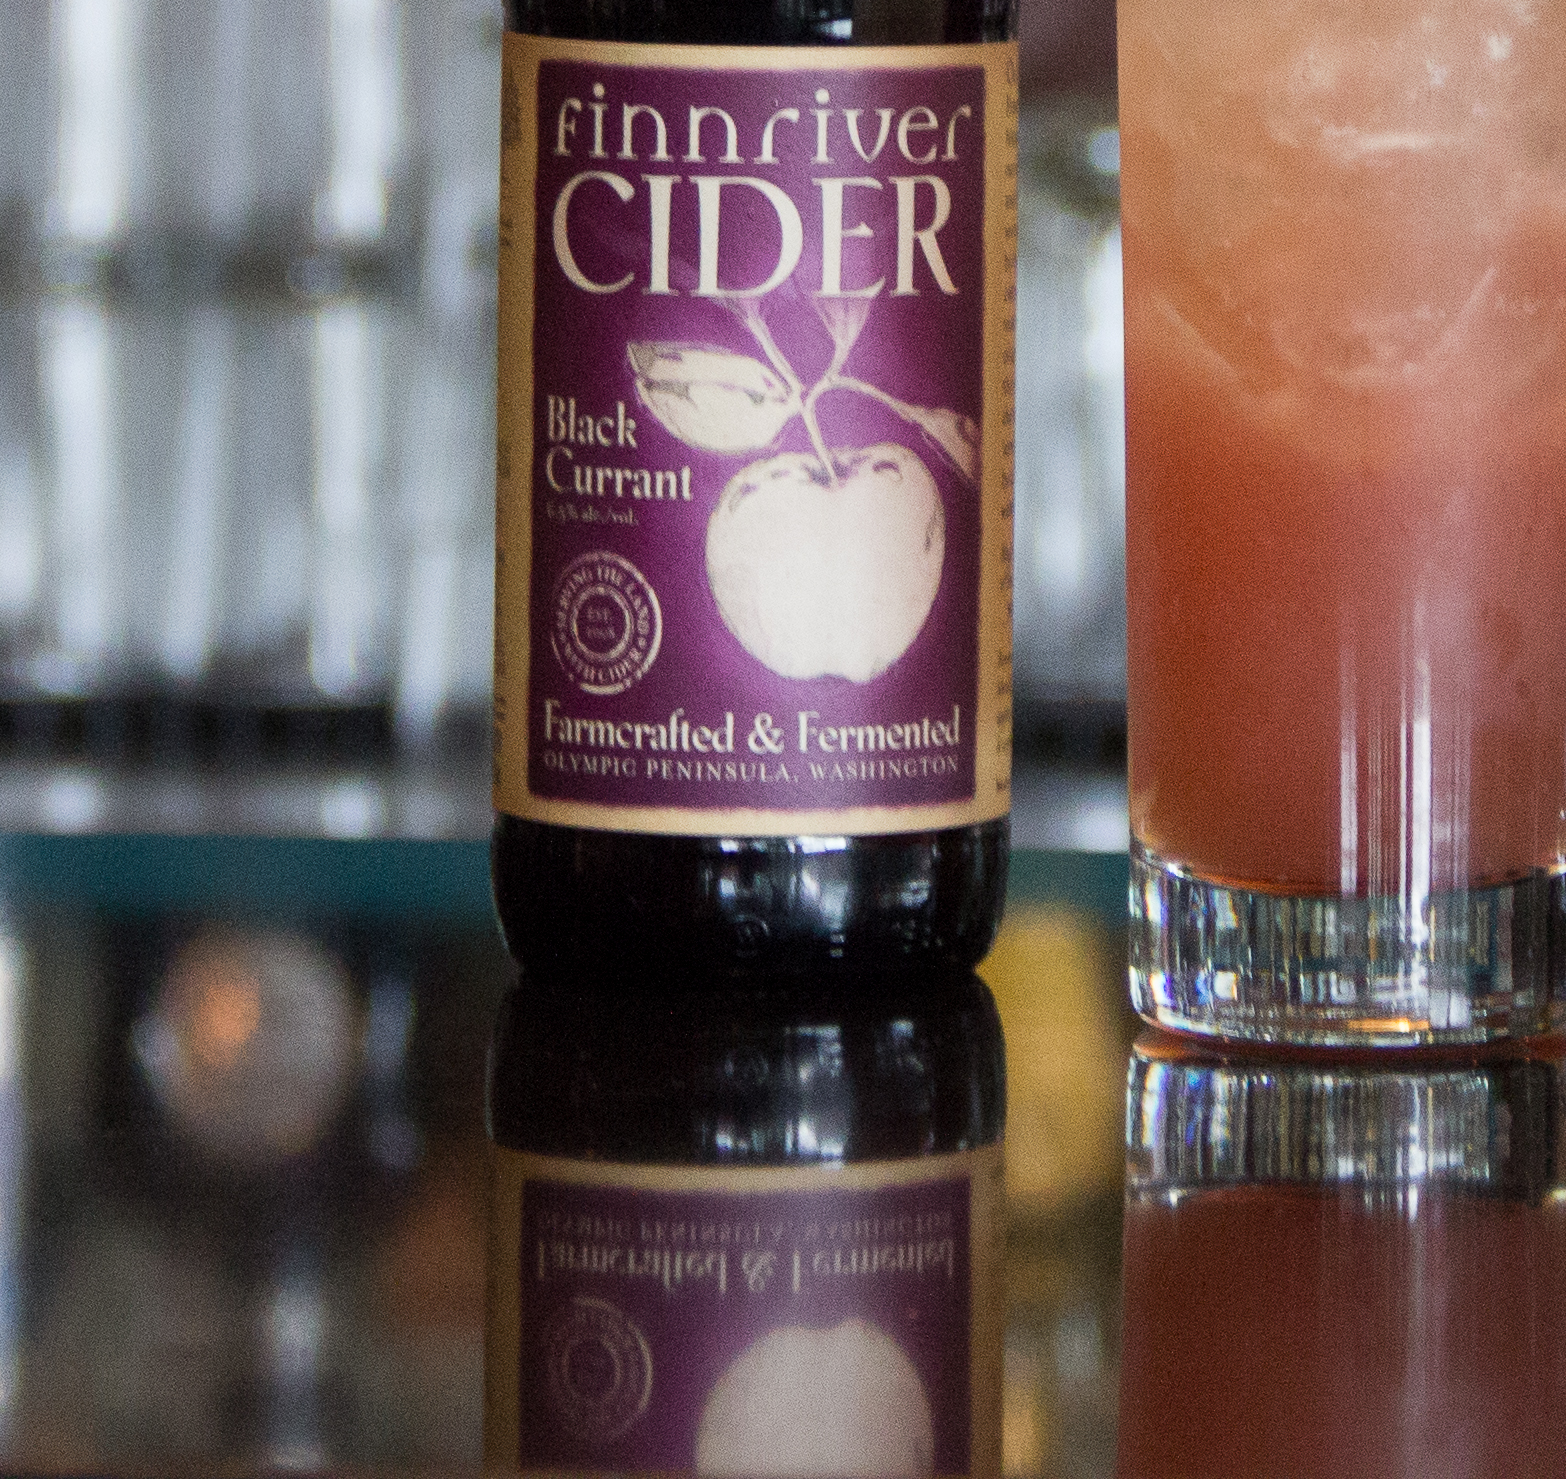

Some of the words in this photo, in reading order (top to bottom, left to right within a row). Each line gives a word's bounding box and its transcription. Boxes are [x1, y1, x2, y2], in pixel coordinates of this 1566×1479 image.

[554, 82, 972, 165] finnriver
[552, 170, 959, 298] CIDER
[546, 394, 638, 448] Black
[545, 445, 693, 502] Currant
[544, 699, 735, 753] Farmcrafted
[747, 712, 784, 755] &
[799, 704, 961, 753] Fermented
[543, 749, 637, 778] OLYMPIC
[809, 753, 959, 781] WASHINGTON
